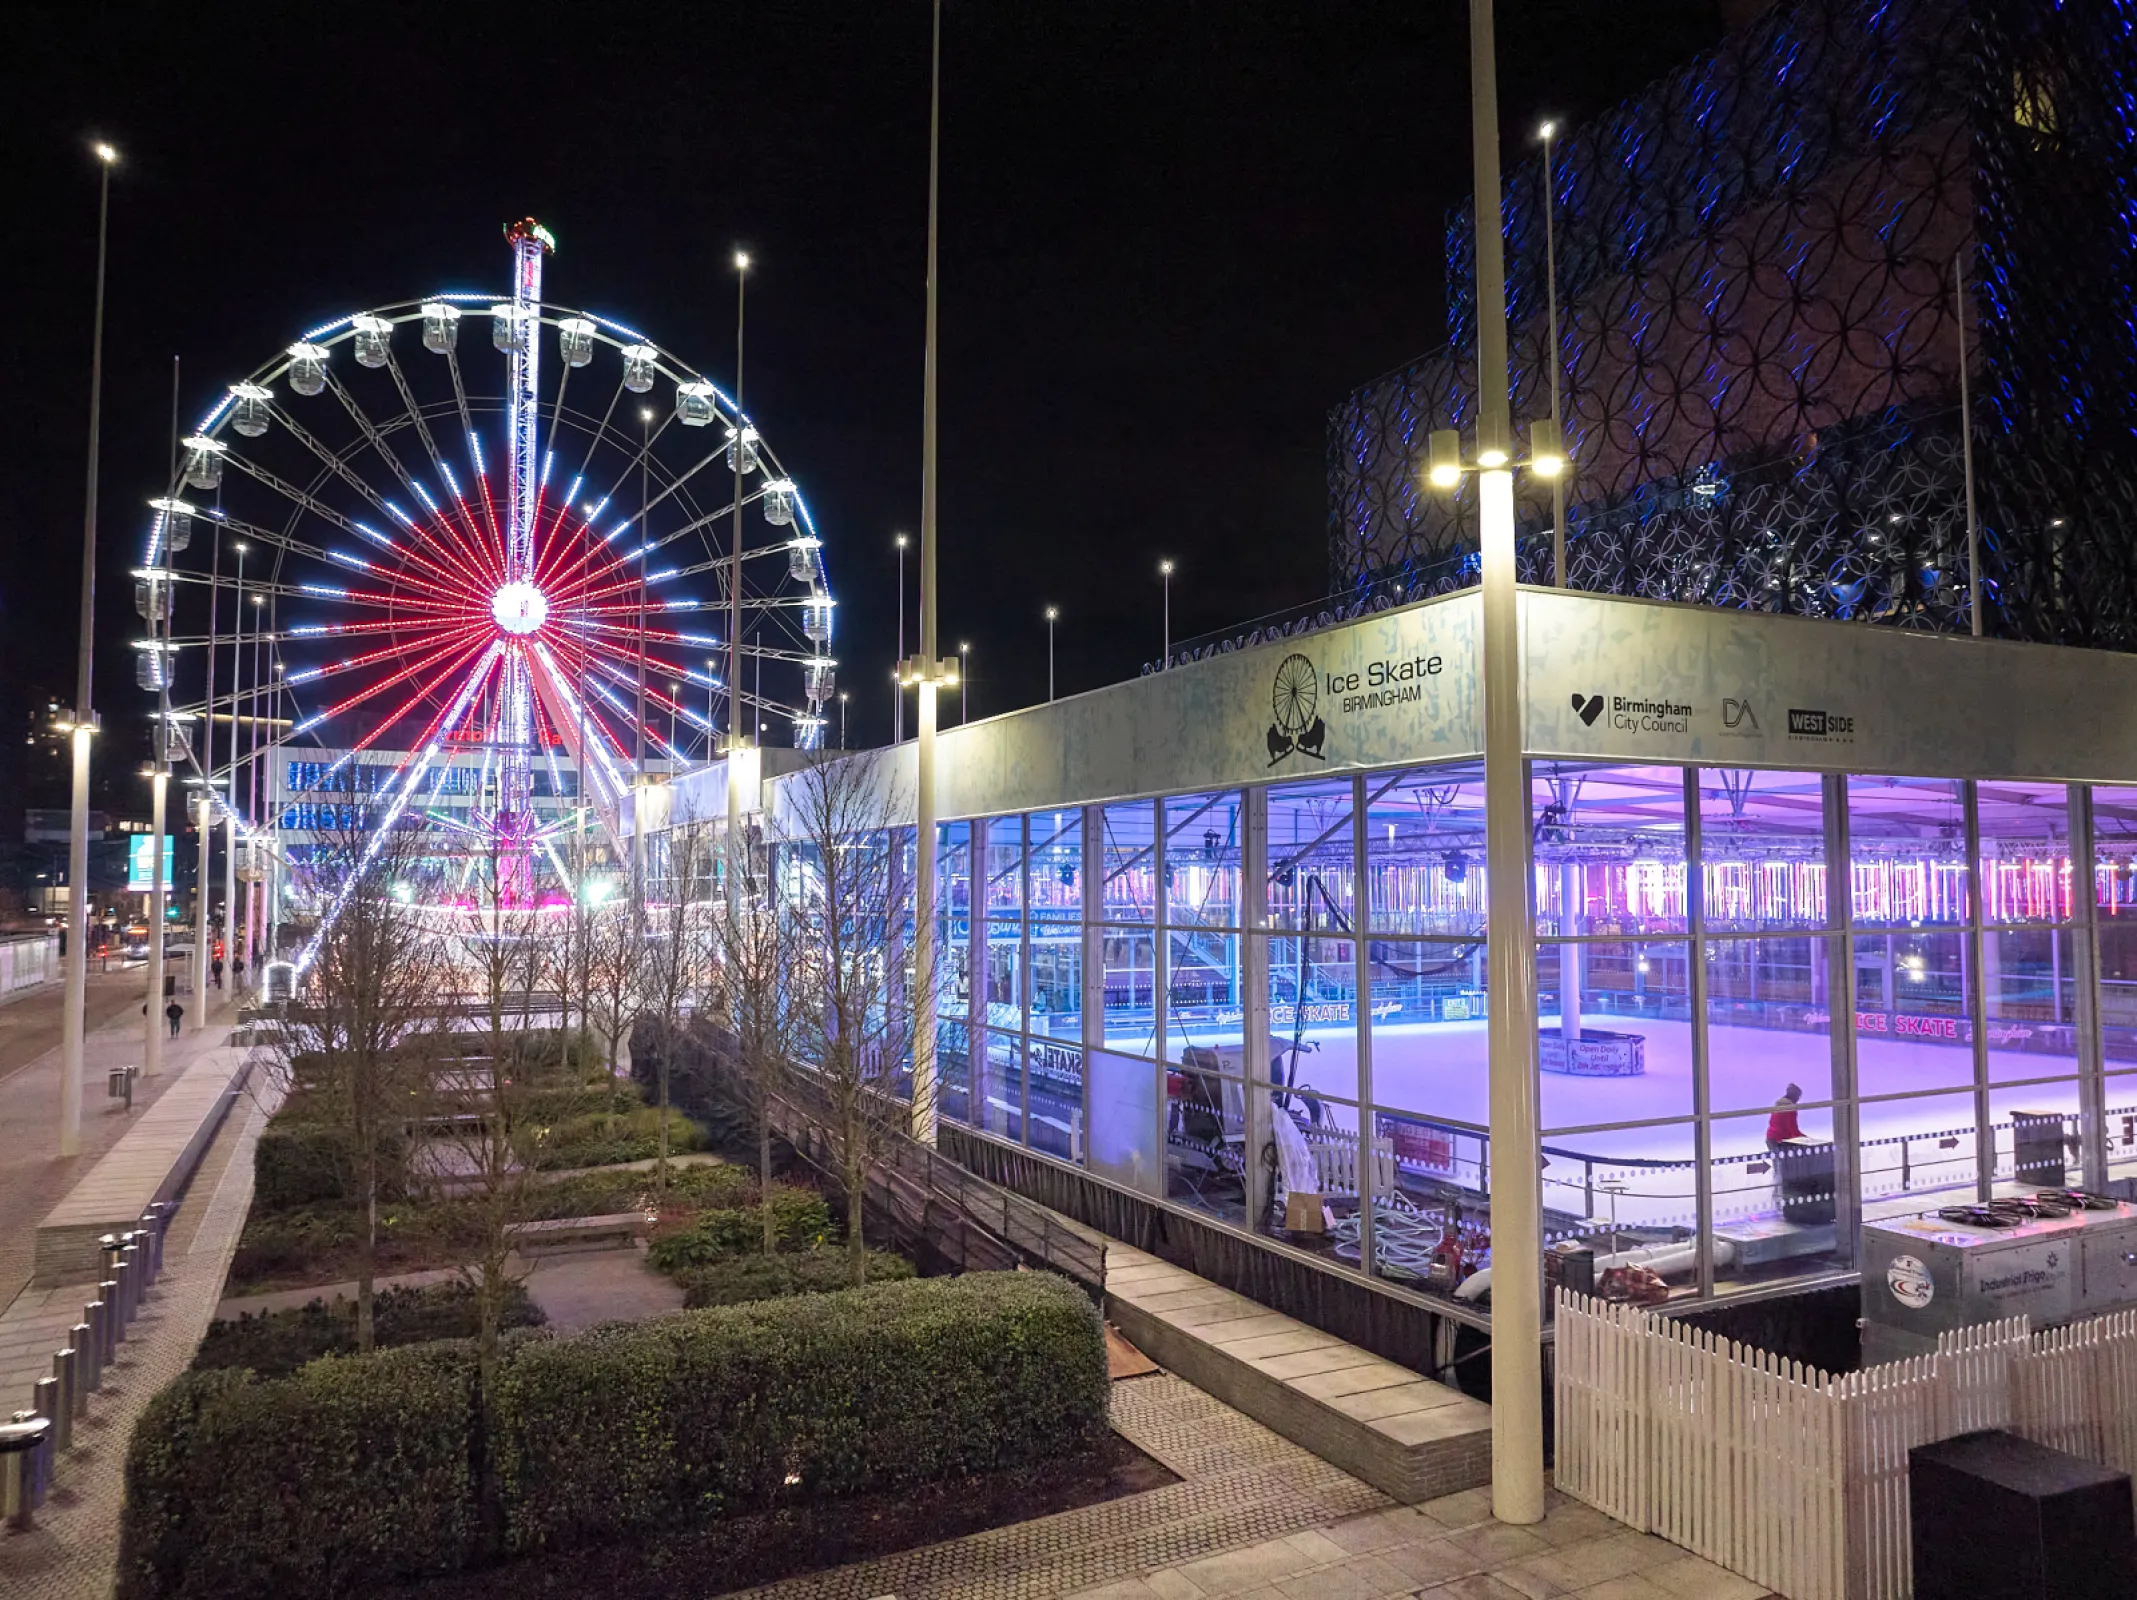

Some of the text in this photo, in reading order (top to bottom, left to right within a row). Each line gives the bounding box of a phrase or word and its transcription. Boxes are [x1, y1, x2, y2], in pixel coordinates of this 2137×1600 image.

[1325, 656, 1442, 695] Ice Skate
[1342, 684, 1421, 713] BIRMINGHAM
[1613, 696, 1692, 718] Birmingham
[1614, 714, 1688, 734] City Council
[1790, 711, 1854, 733] WEST SIDE
[1855, 1011, 1888, 1032] ICE
[1895, 1016, 1957, 1039] SKATE
[2023, 1269, 2046, 1284] Frigo
